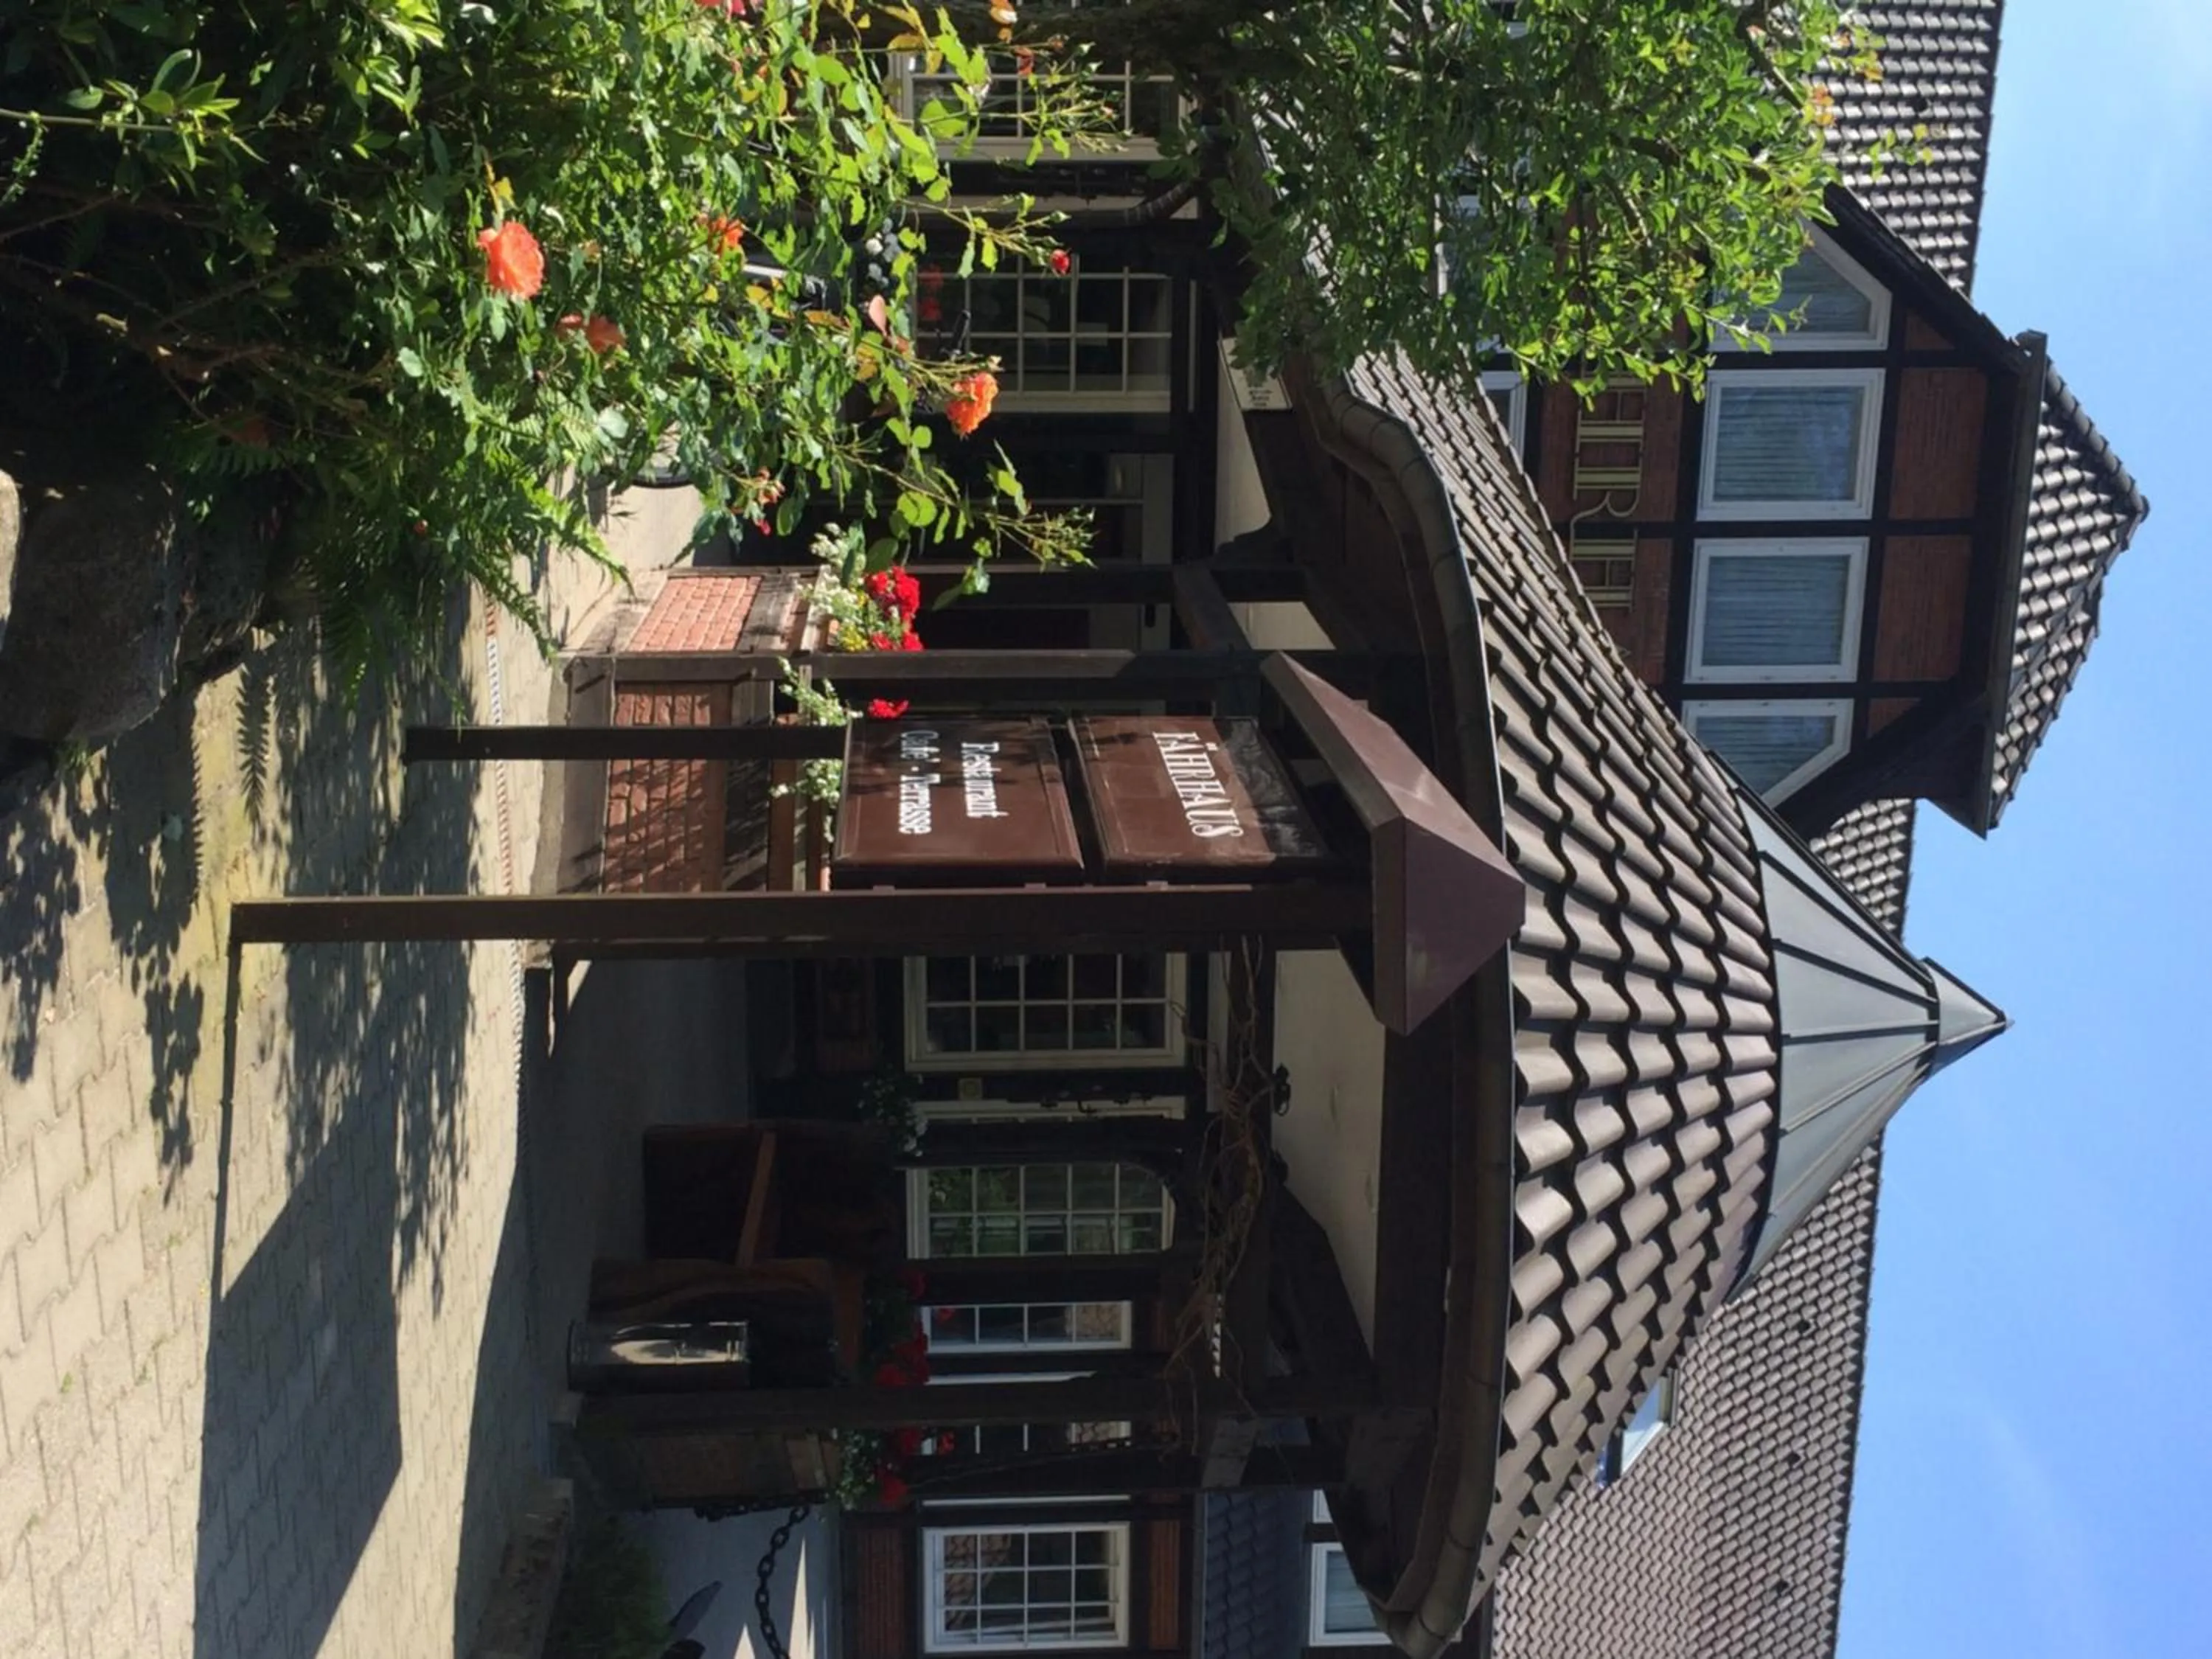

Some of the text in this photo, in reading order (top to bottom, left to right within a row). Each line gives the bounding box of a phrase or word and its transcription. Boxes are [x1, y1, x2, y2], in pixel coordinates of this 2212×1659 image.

[898, 773, 940, 834] Terrasse
[961, 742, 1008, 818] Restaurant
[1152, 731, 1244, 837] FÄHRHAUS
